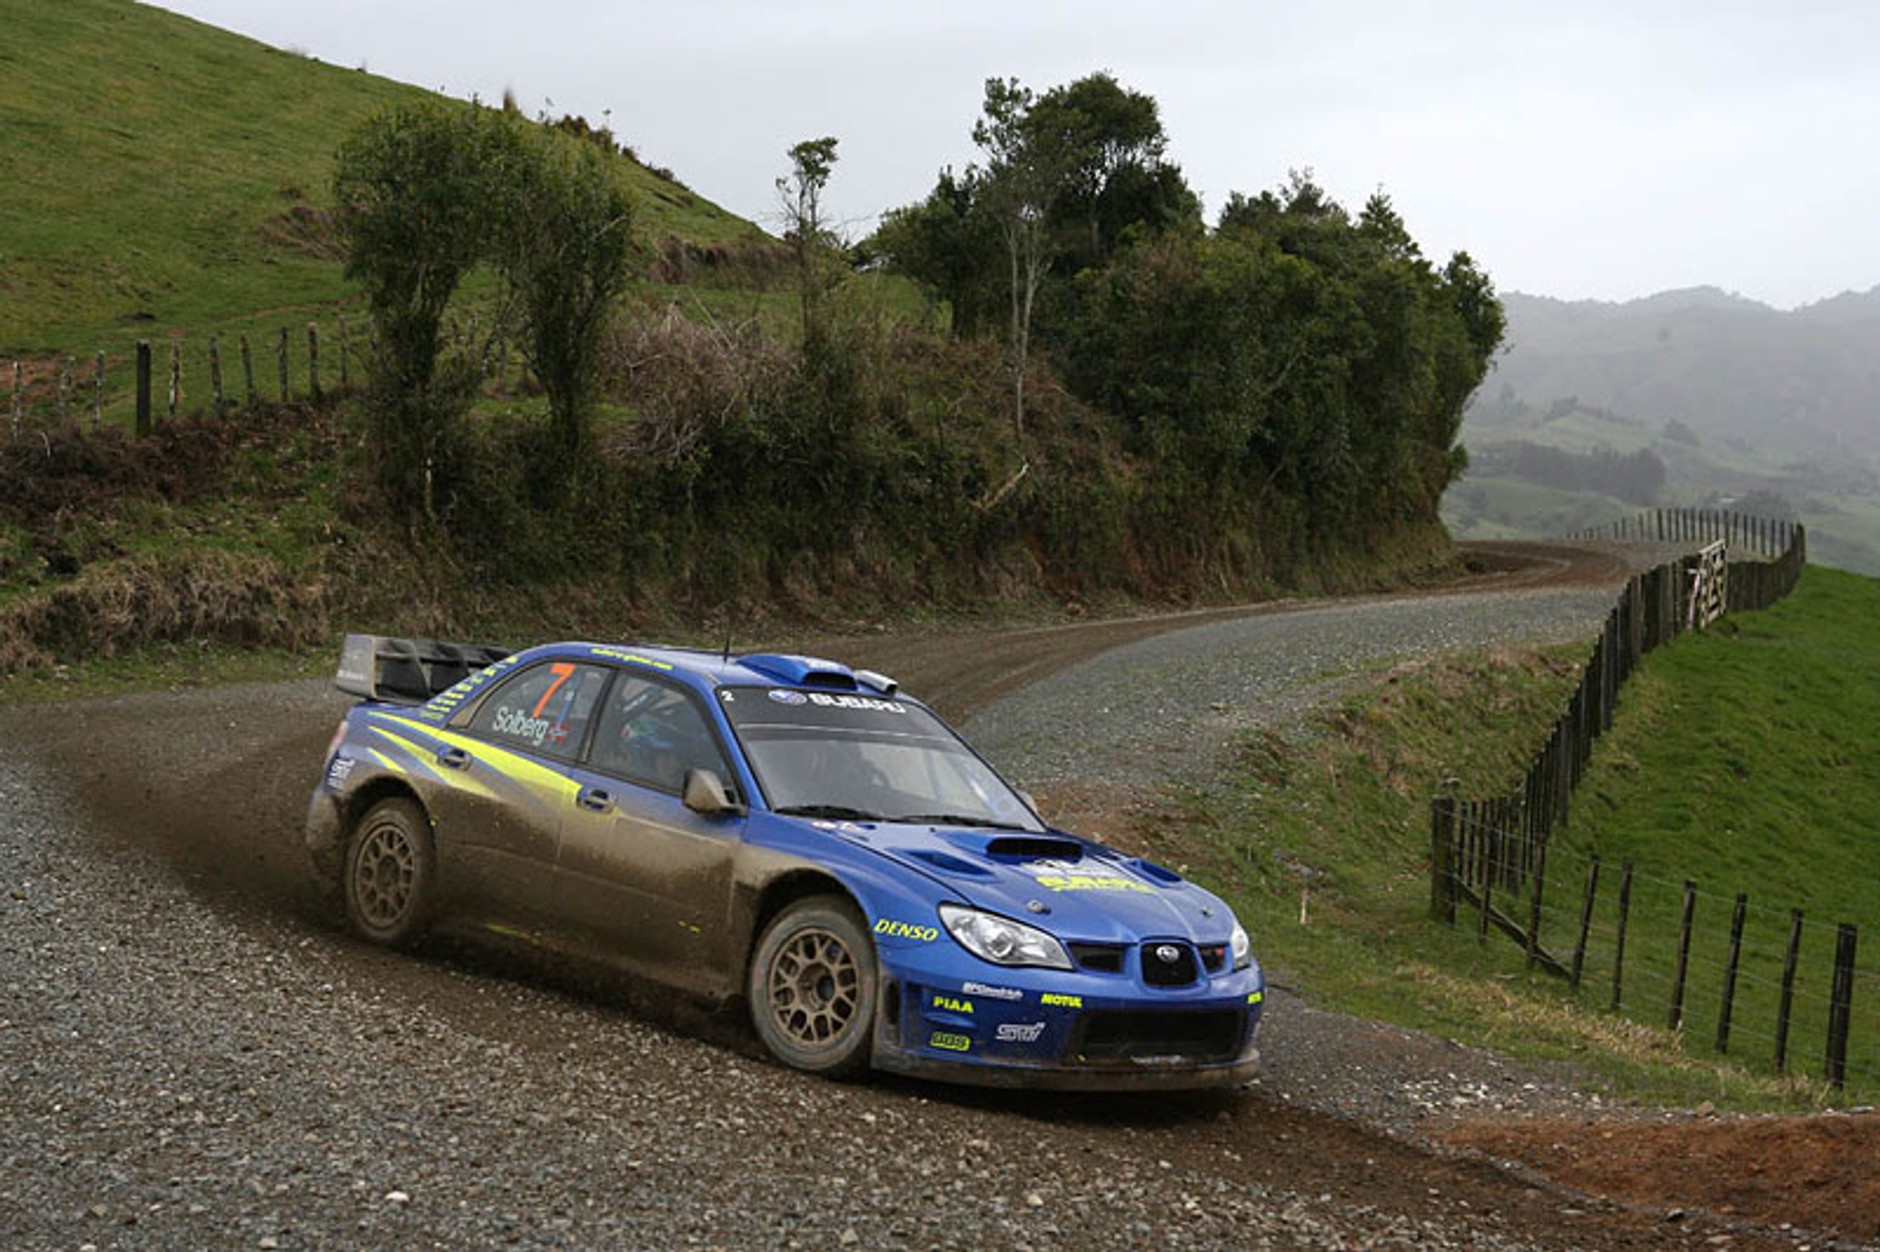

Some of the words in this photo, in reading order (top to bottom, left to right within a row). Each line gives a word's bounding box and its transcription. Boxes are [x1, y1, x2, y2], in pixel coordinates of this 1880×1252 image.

[532, 662, 576, 718] 7
[721, 690, 734, 701] 2
[492, 706, 549, 746] Solberg
[874, 918, 939, 941] DENSO
[933, 996, 974, 1013] PIAA
[1041, 993, 1083, 1008] MOTUL
